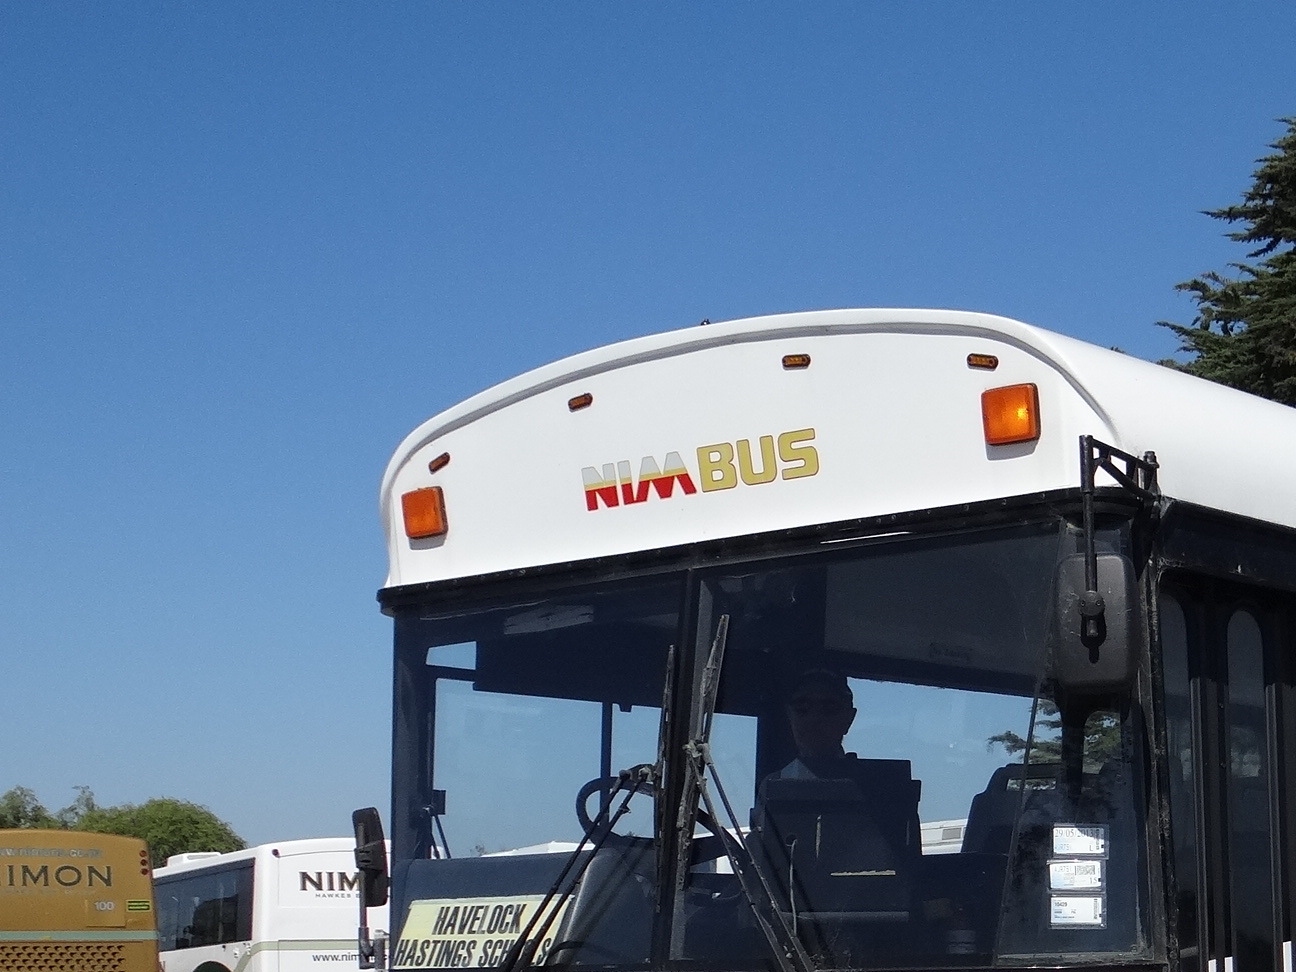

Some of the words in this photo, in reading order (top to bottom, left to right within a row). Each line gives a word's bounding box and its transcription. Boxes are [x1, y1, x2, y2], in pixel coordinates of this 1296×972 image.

[0, 865, 112, 887] IMON
[299, 871, 362, 891] NIM
[94, 901, 115, 911] 100
[431, 903, 527, 936] HAVELOCK
[393, 938, 477, 967] HASTINGS
